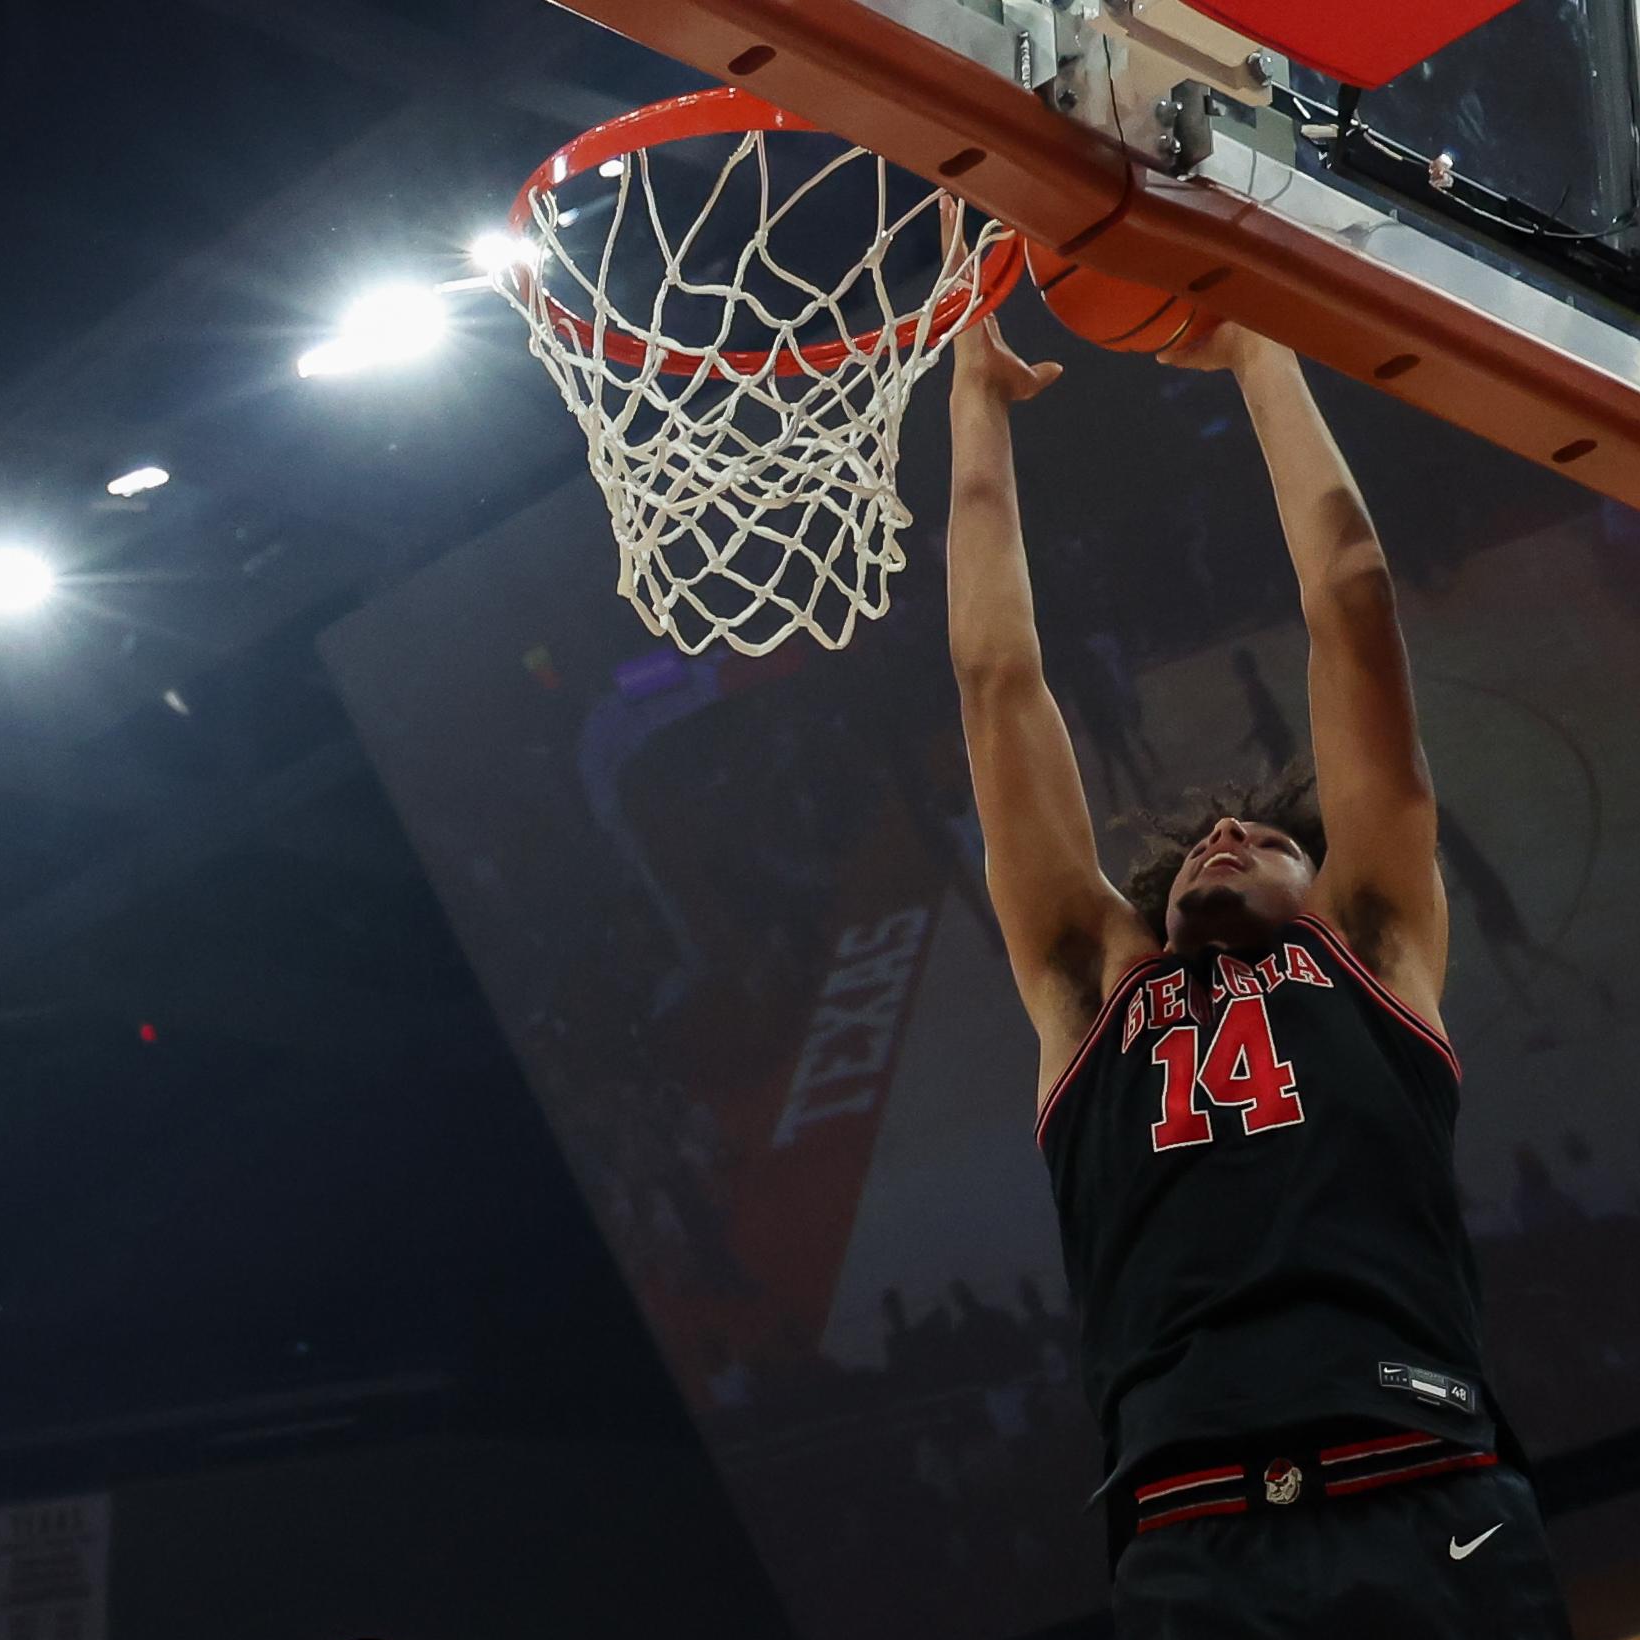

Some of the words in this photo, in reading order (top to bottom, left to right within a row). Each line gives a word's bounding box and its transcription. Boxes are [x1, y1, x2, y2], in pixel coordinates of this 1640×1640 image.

[770, 904, 932, 1151] TEXAS
[1120, 942, 1334, 1055] GEGIA
[1151, 993, 1306, 1153] 14
